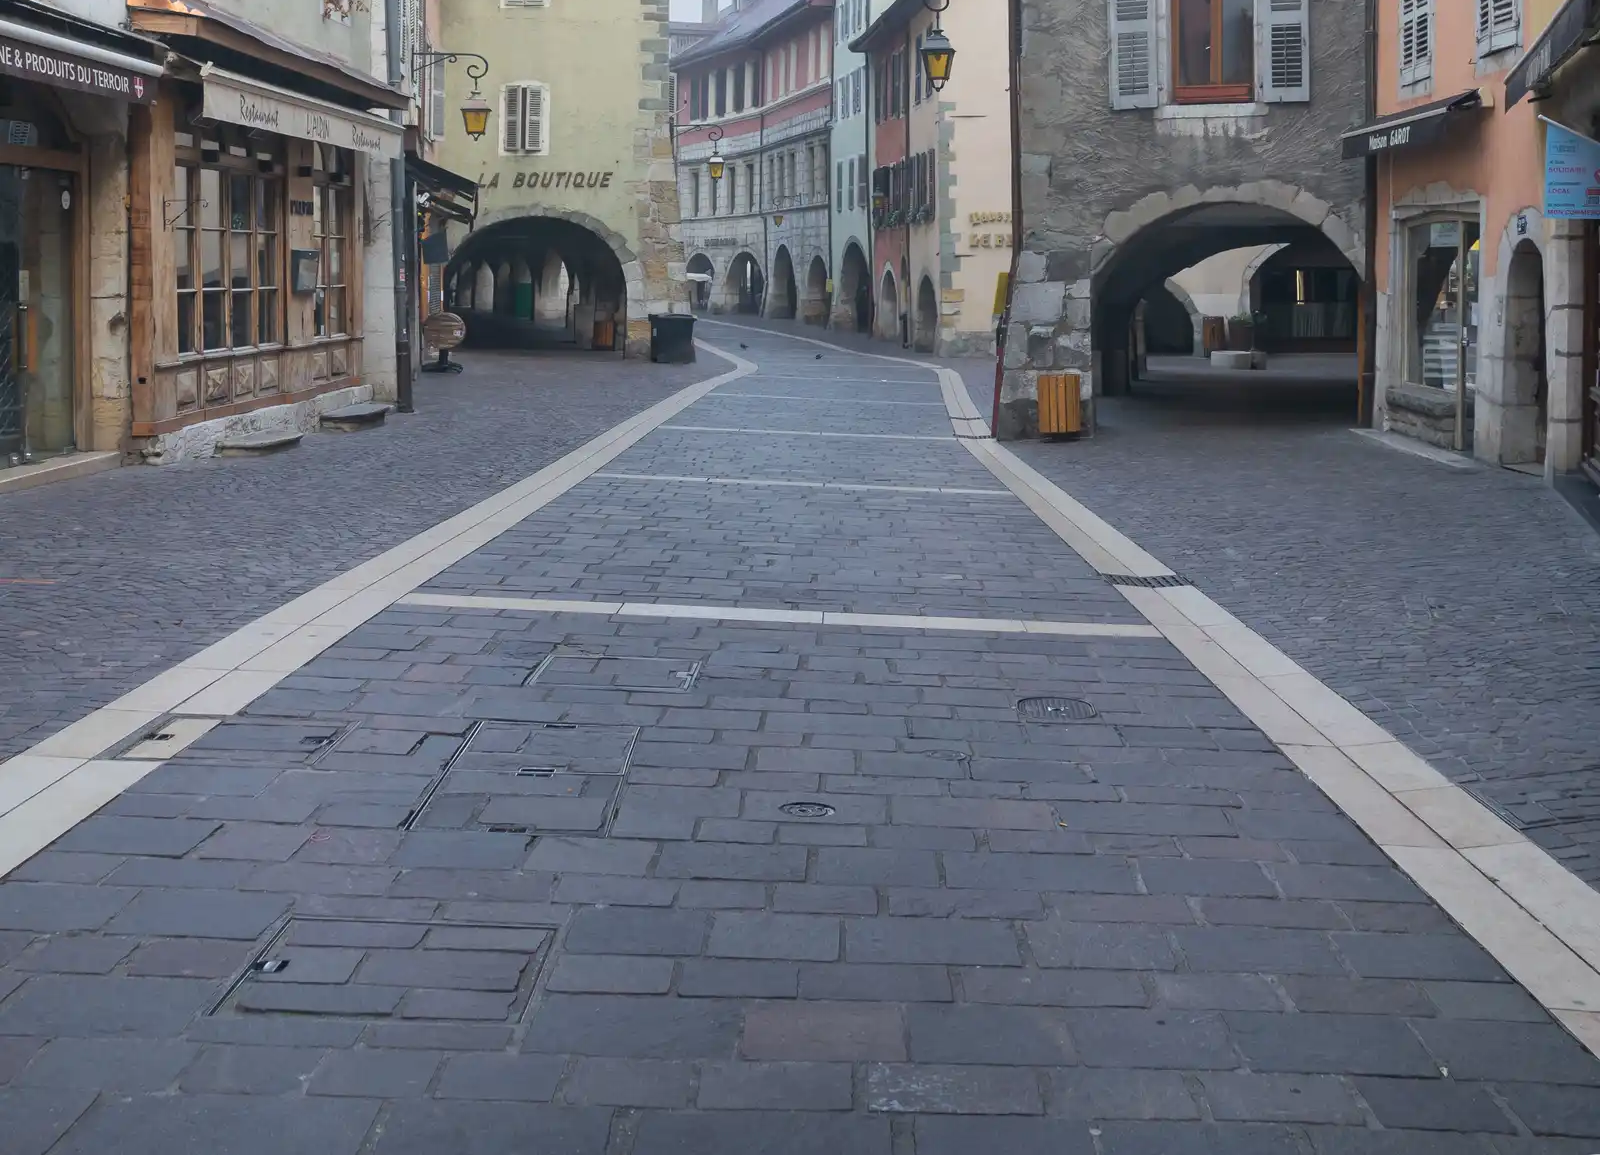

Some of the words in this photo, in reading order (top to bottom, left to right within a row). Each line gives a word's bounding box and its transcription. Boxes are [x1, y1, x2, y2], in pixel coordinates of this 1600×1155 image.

[14, 49, 23, 68] &
[25, 51, 75, 81] PRODUITS
[77, 65, 91, 84] DU
[92, 69, 130, 94] TERROIR
[240, 93, 279, 128] Restaurant
[351, 124, 381, 151] Restaurant
[1369, 133, 1388, 151] Maison
[1389, 126, 1411, 146] GAROT
[478, 172, 500, 189] LA
[512, 171, 614, 189] BOUTIQUE
